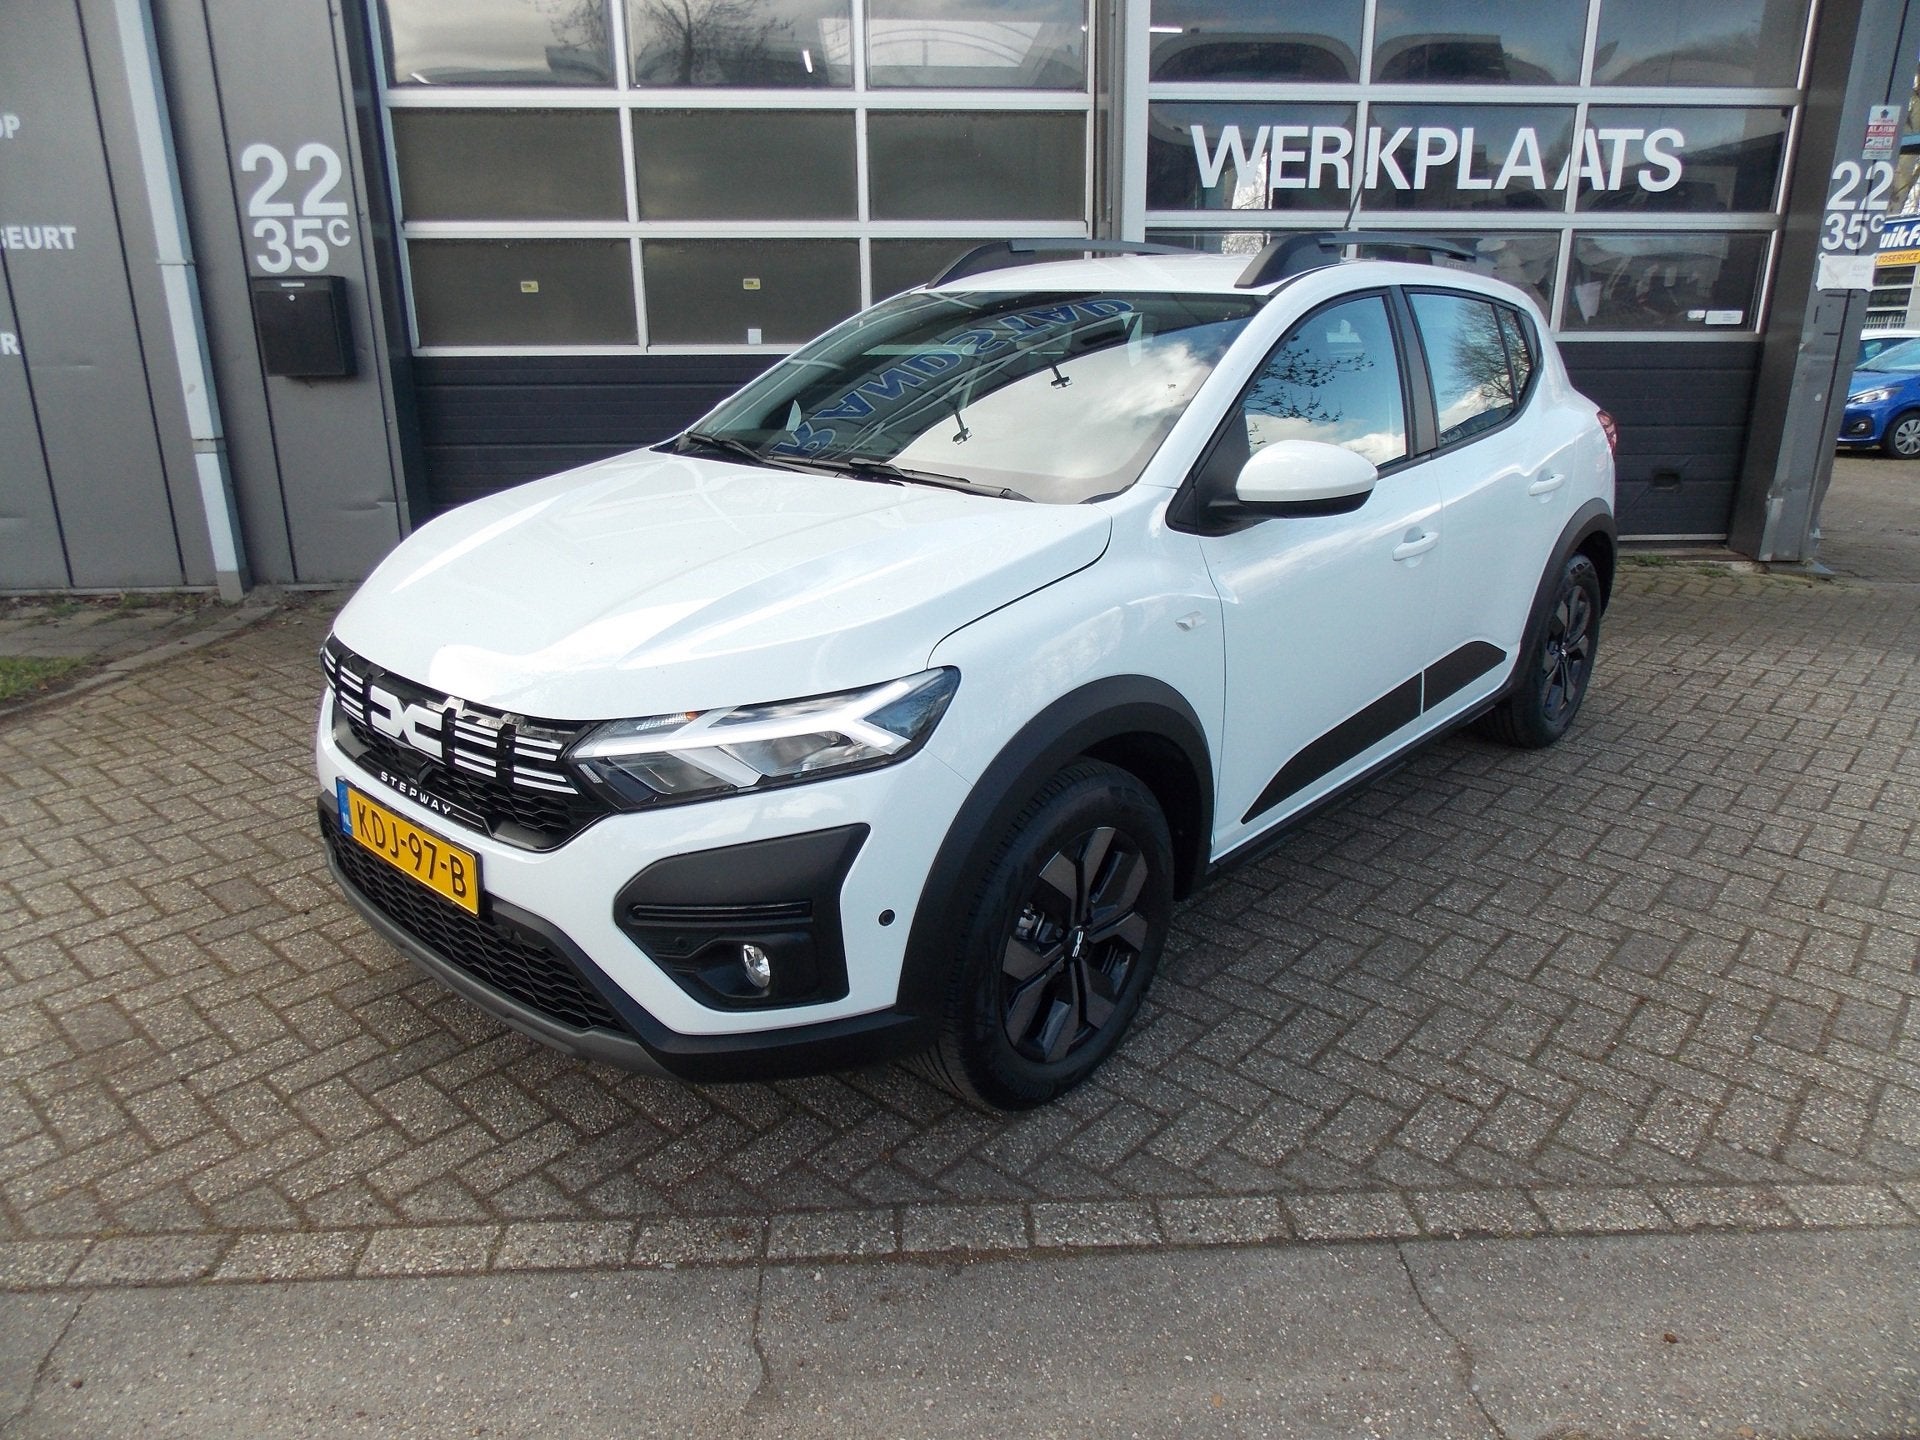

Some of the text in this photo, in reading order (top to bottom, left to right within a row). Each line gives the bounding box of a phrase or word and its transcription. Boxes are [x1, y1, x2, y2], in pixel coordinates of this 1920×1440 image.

[0, 115, 20, 139] P
[241, 143, 348, 217] 22
[1190, 125, 1685, 193] WERKPLAATS
[1826, 160, 1894, 210] 22
[381, 771, 451, 815] STEPWAY
[356, 800, 467, 898] KDJ-97-B
